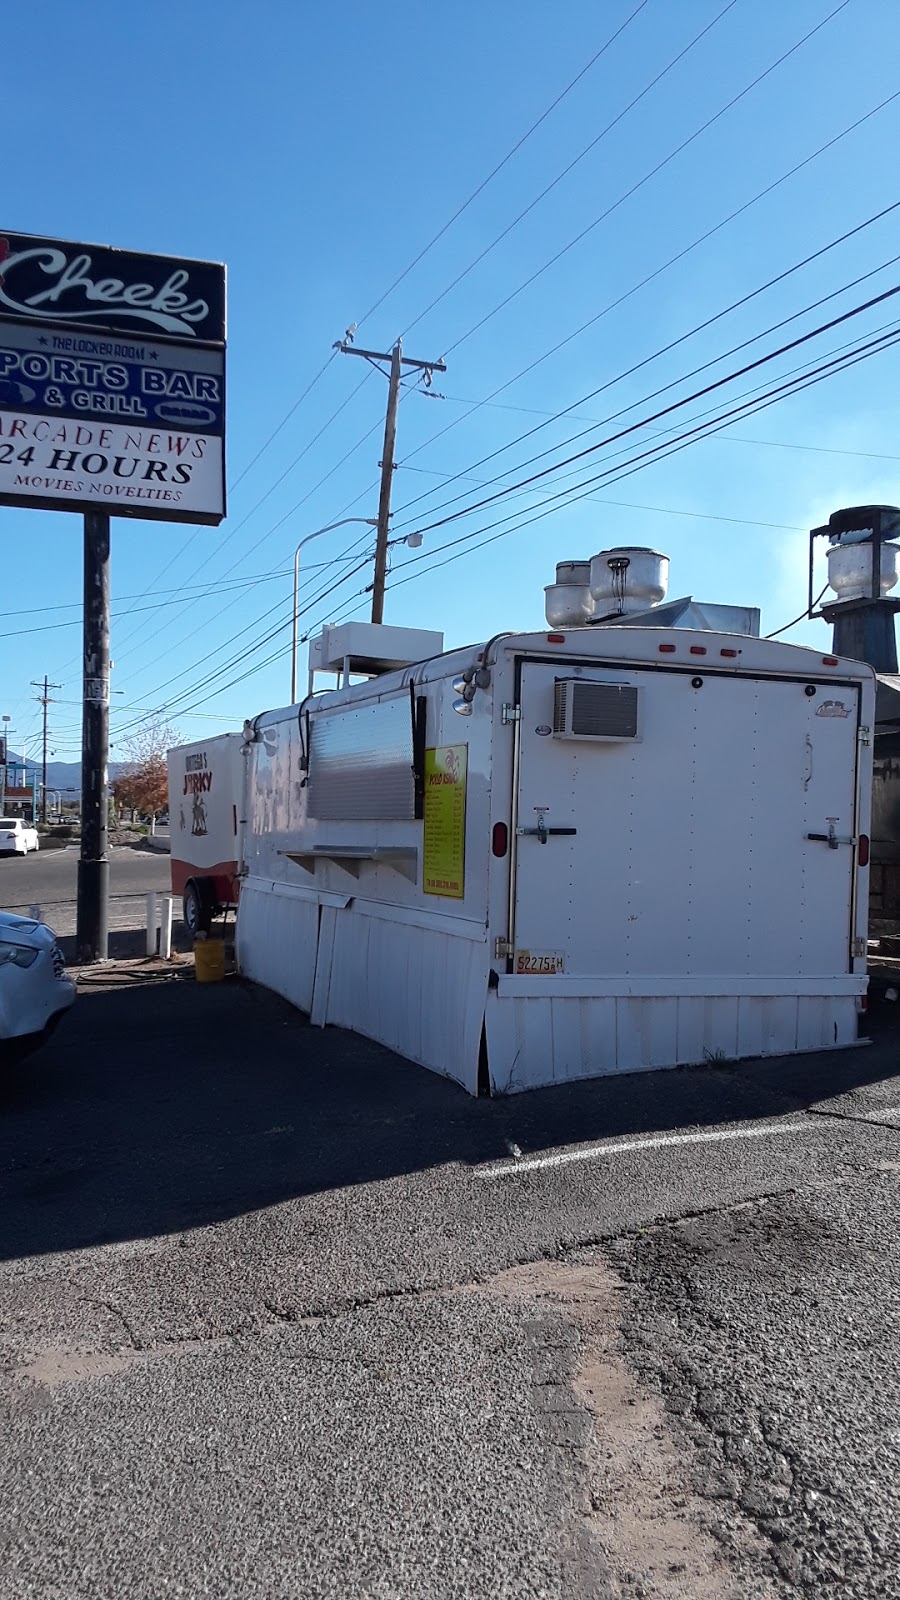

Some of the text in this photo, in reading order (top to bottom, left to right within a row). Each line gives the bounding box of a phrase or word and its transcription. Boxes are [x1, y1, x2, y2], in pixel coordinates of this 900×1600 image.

[0, 247, 209, 336] Cheeks
[114, 344, 145, 360] ROOM
[141, 367, 221, 402] BAR
[44, 386, 65, 407] &
[70, 389, 147, 418] GRILL
[125, 432, 207, 458] NEWS
[0, 443, 193, 484] 24 HOURS
[13, 474, 183, 502] MOVIES NOVELTIES
[183, 770, 212, 796] JERKY
